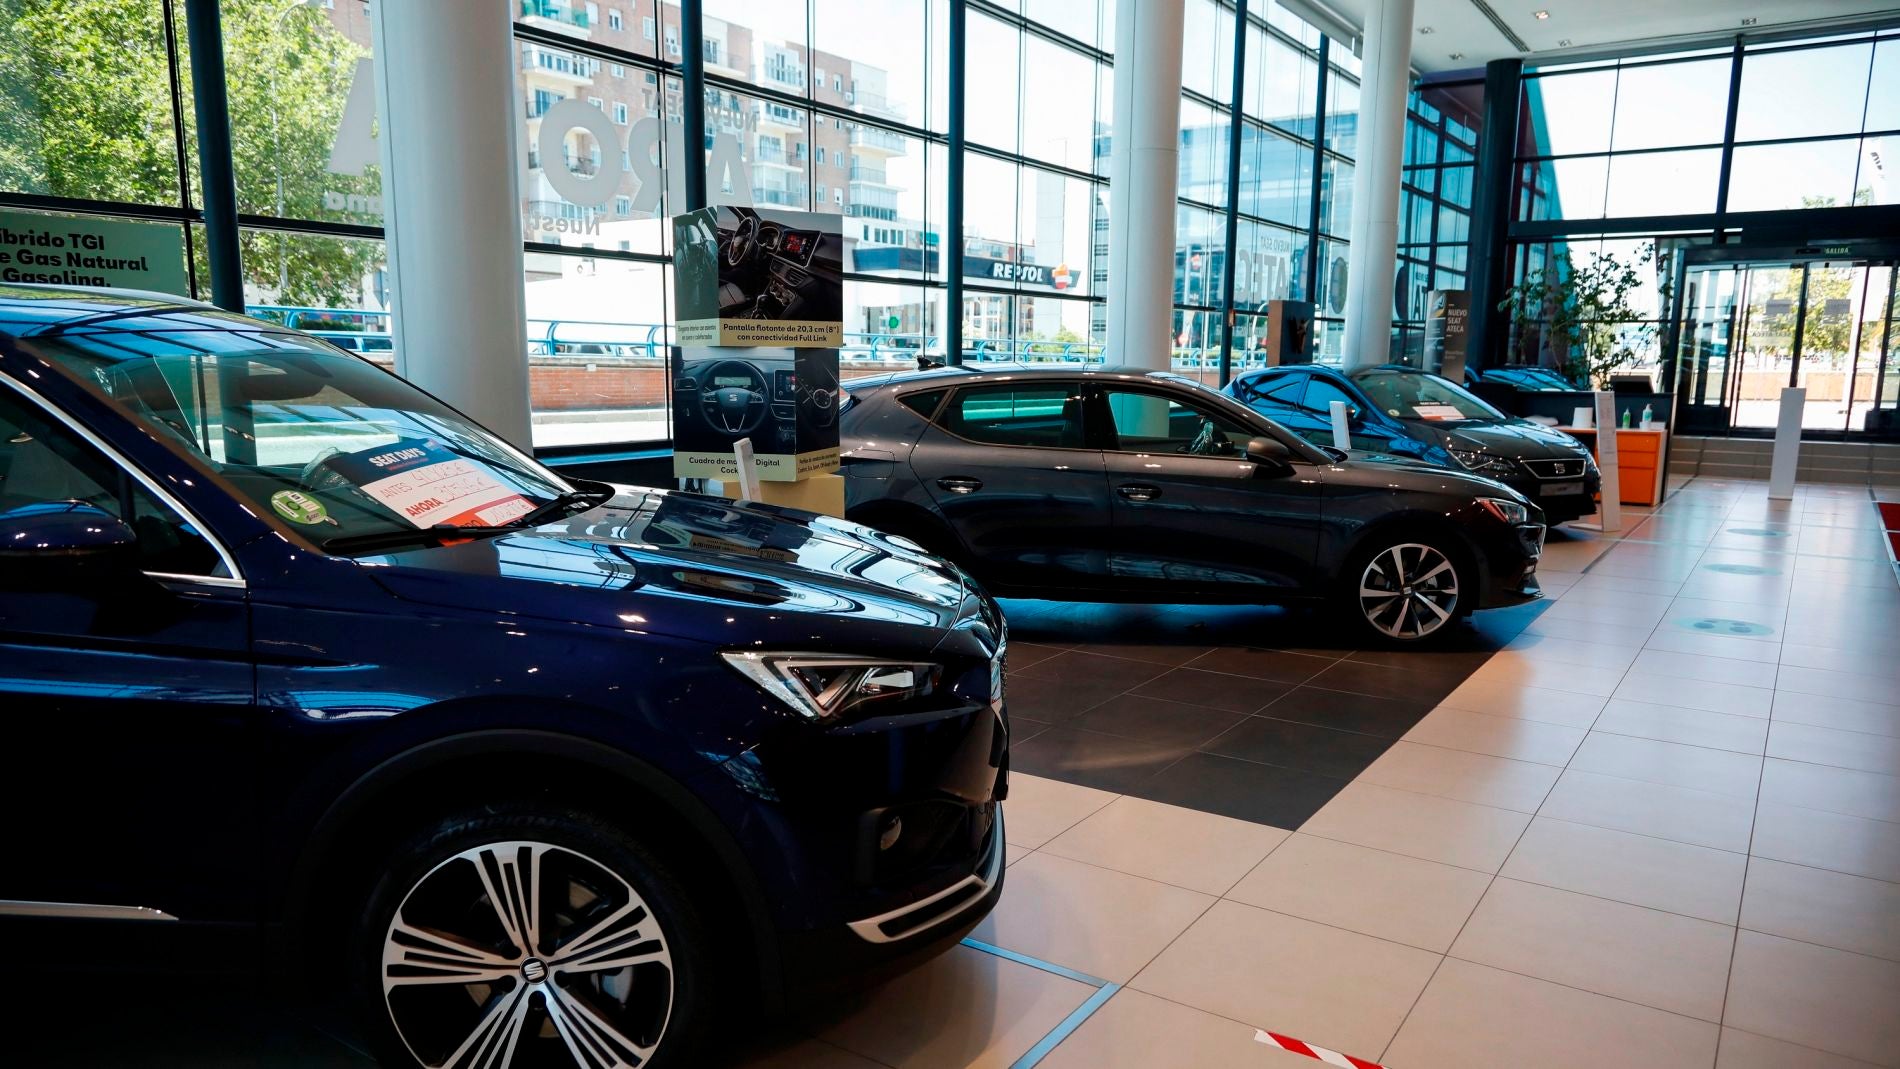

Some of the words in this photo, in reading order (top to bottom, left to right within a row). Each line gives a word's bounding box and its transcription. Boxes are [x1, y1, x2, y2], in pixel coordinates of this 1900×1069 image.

[68, 233, 105, 251] TGI
[16, 249, 62, 267] Gas
[66, 251, 149, 272] Natural
[2, 267, 111, 287] Gasolina.
[993, 262, 1043, 282] REPSOL
[1447, 309, 1467, 317] NUEVO
[797, 325, 813, 333] 20,3
[1446, 325, 1464, 333] ATECA
[368, 451, 400, 467] SEAT
[397, 447, 427, 461] DAYS
[689, 457, 715, 465] Cuadro
[716, 457, 725, 465] de
[755, 459, 780, 467] Digital
[720, 466, 739, 474] Cock
[405, 497, 445, 517] AHORA
